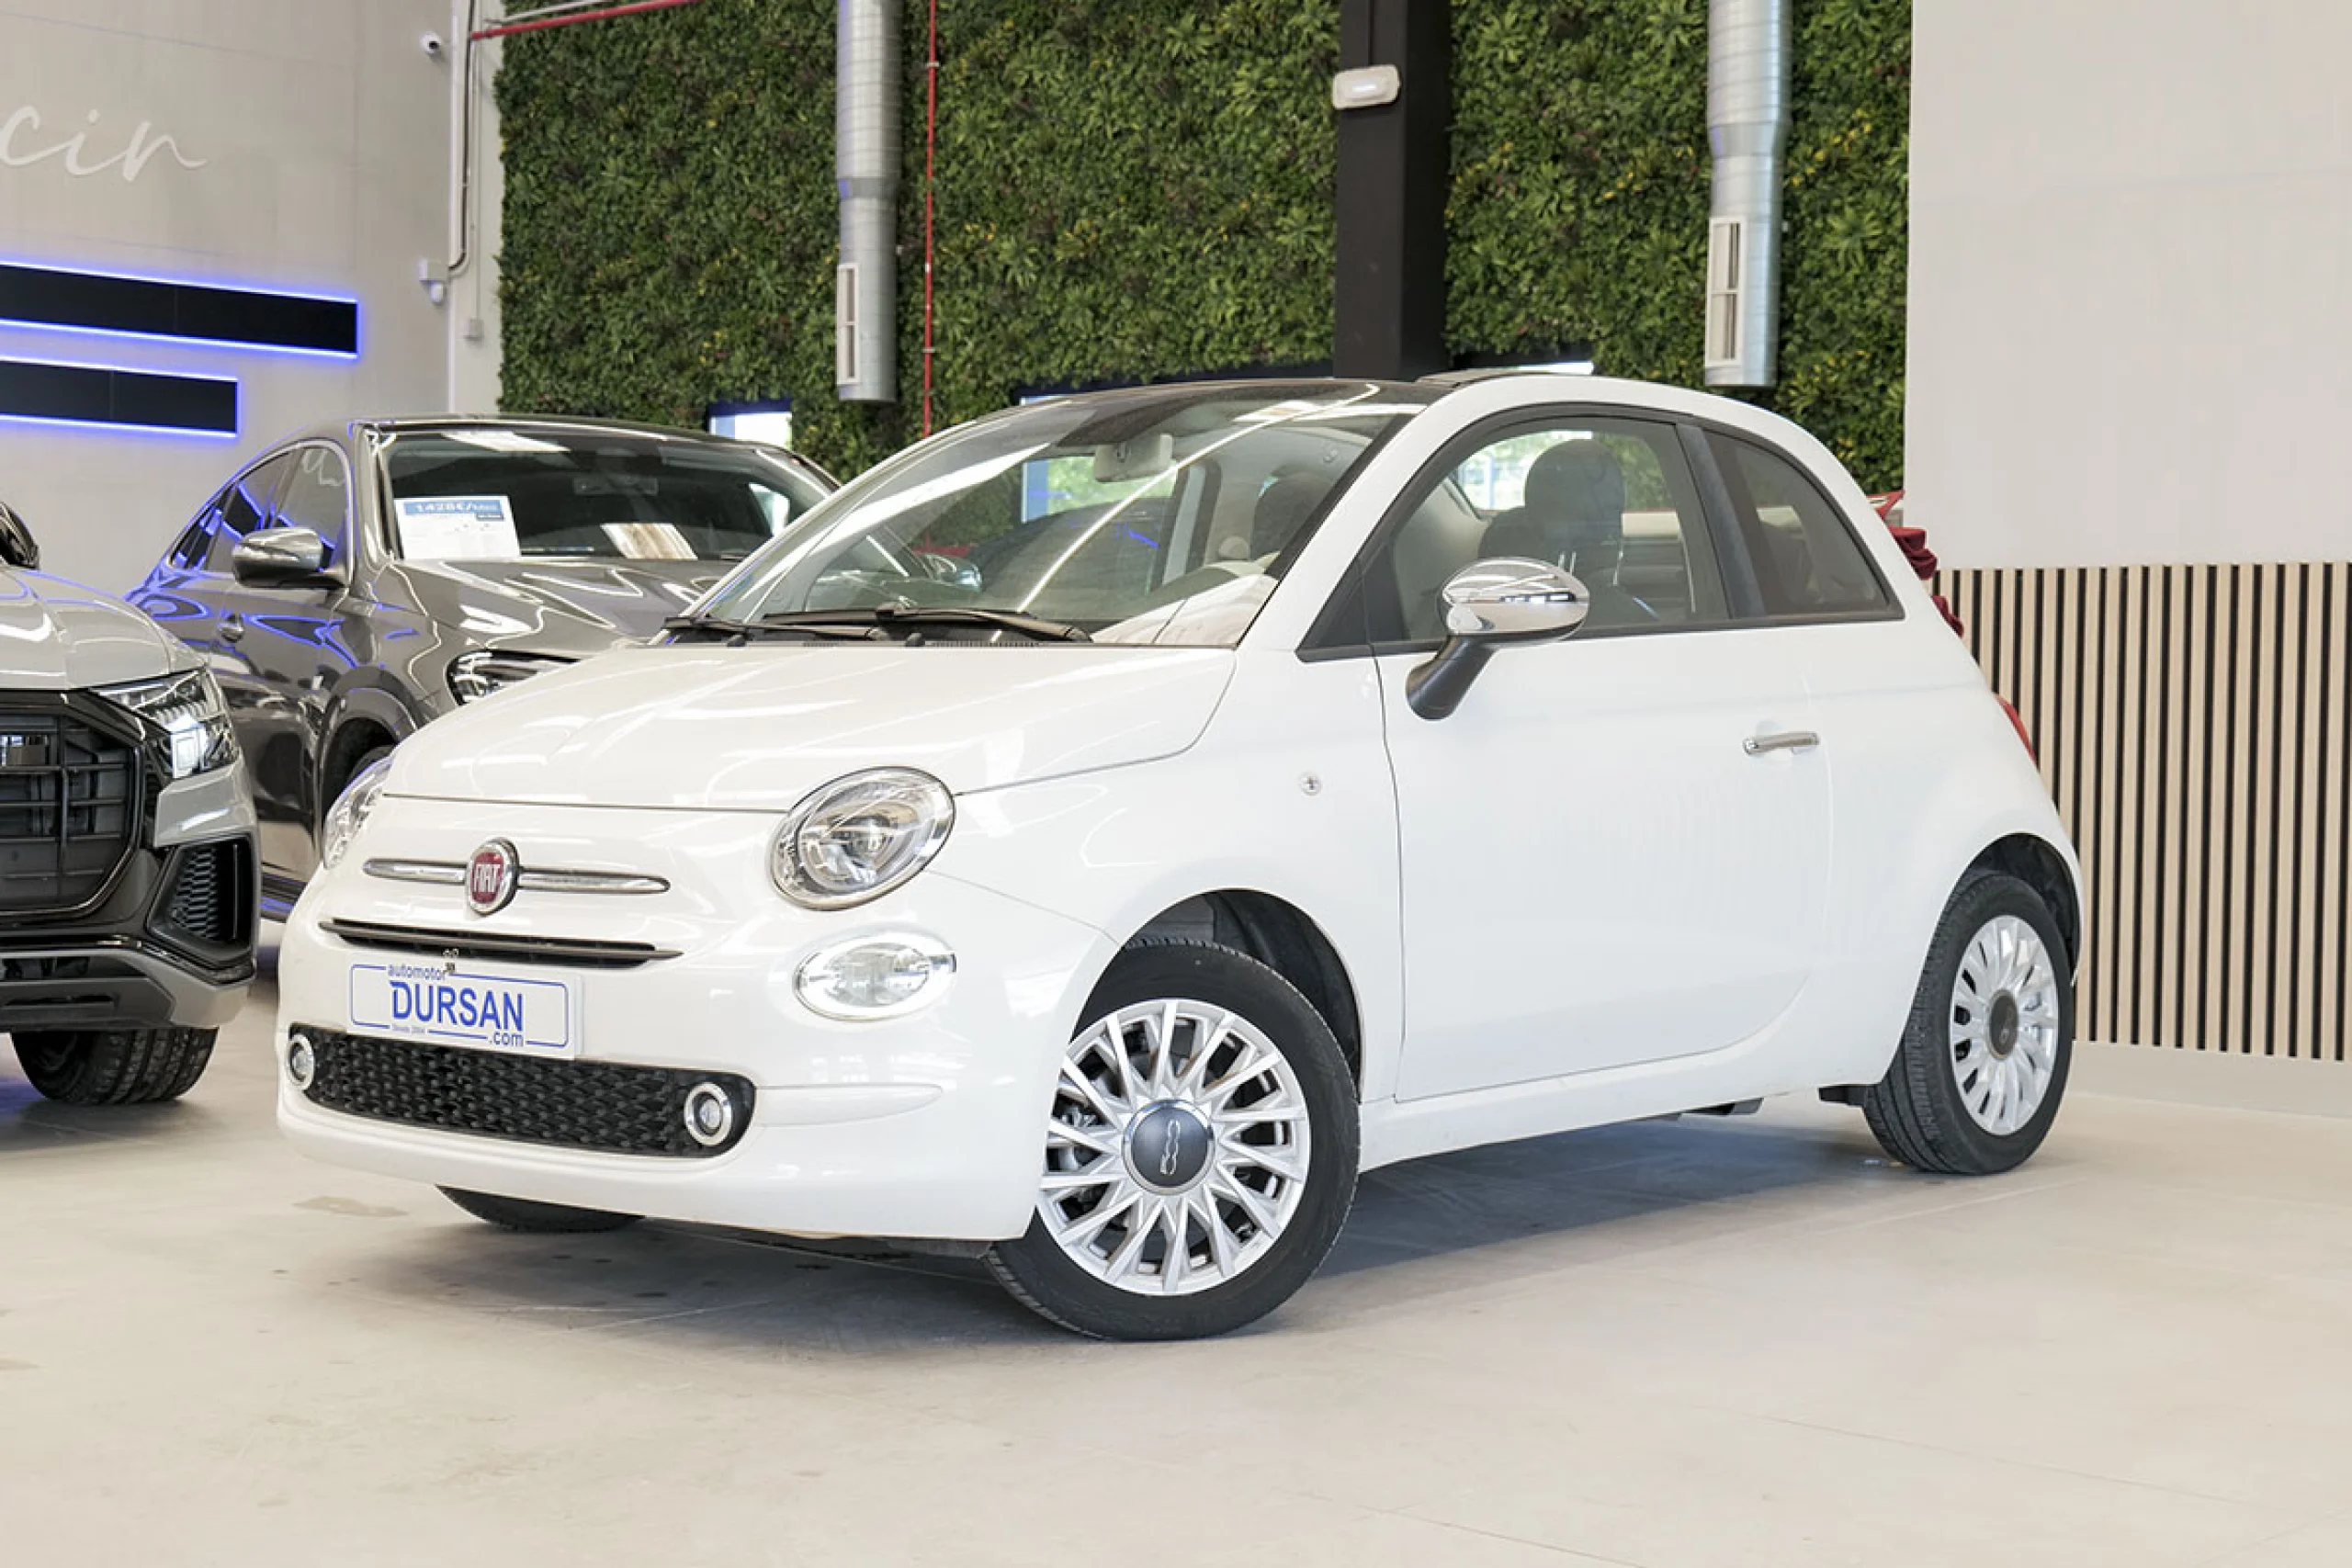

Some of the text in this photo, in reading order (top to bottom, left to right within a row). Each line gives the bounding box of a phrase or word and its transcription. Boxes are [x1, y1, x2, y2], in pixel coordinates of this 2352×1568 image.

[473, 863, 501, 893] FIAT
[388, 964, 446, 981] automotor
[389, 980, 524, 1032] DURSAN
[489, 1032, 525, 1047] .com
